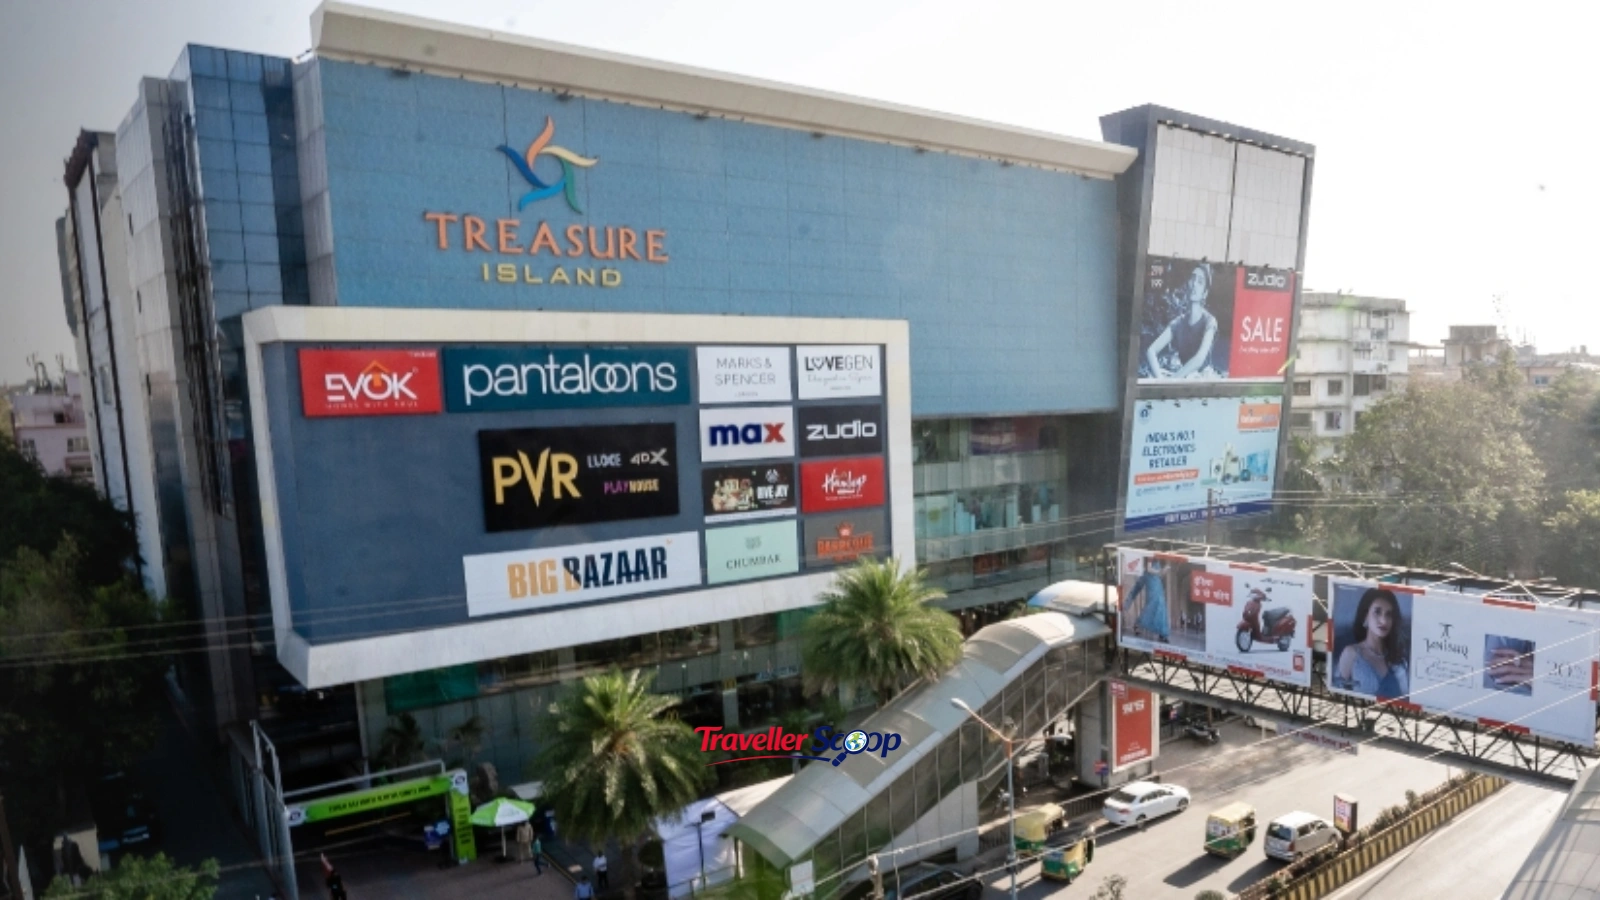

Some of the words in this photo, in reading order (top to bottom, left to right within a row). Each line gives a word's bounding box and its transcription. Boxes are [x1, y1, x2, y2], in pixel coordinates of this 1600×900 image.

[425, 211, 670, 263] TREASURE
[482, 263, 622, 288] ISLAND
[1240, 315, 1284, 343] SALE
[716, 357, 762, 370] MARKS
[763, 357, 773, 369] &
[325, 372, 418, 402] EVOK
[462, 353, 678, 406] pantaloons
[714, 373, 776, 387] SPENCER
[709, 422, 786, 447] max
[806, 419, 877, 441] zudio
[1142, 444, 1197, 458] ELECTRONICS
[1149, 455, 1188, 470] RETAILER
[491, 447, 582, 508] PVR
[603, 478, 660, 495] PLAYHOUSE
[507, 557, 558, 599] BIG
[563, 545, 668, 592] BAZAAR
[726, 554, 781, 570] CHUMBAK
